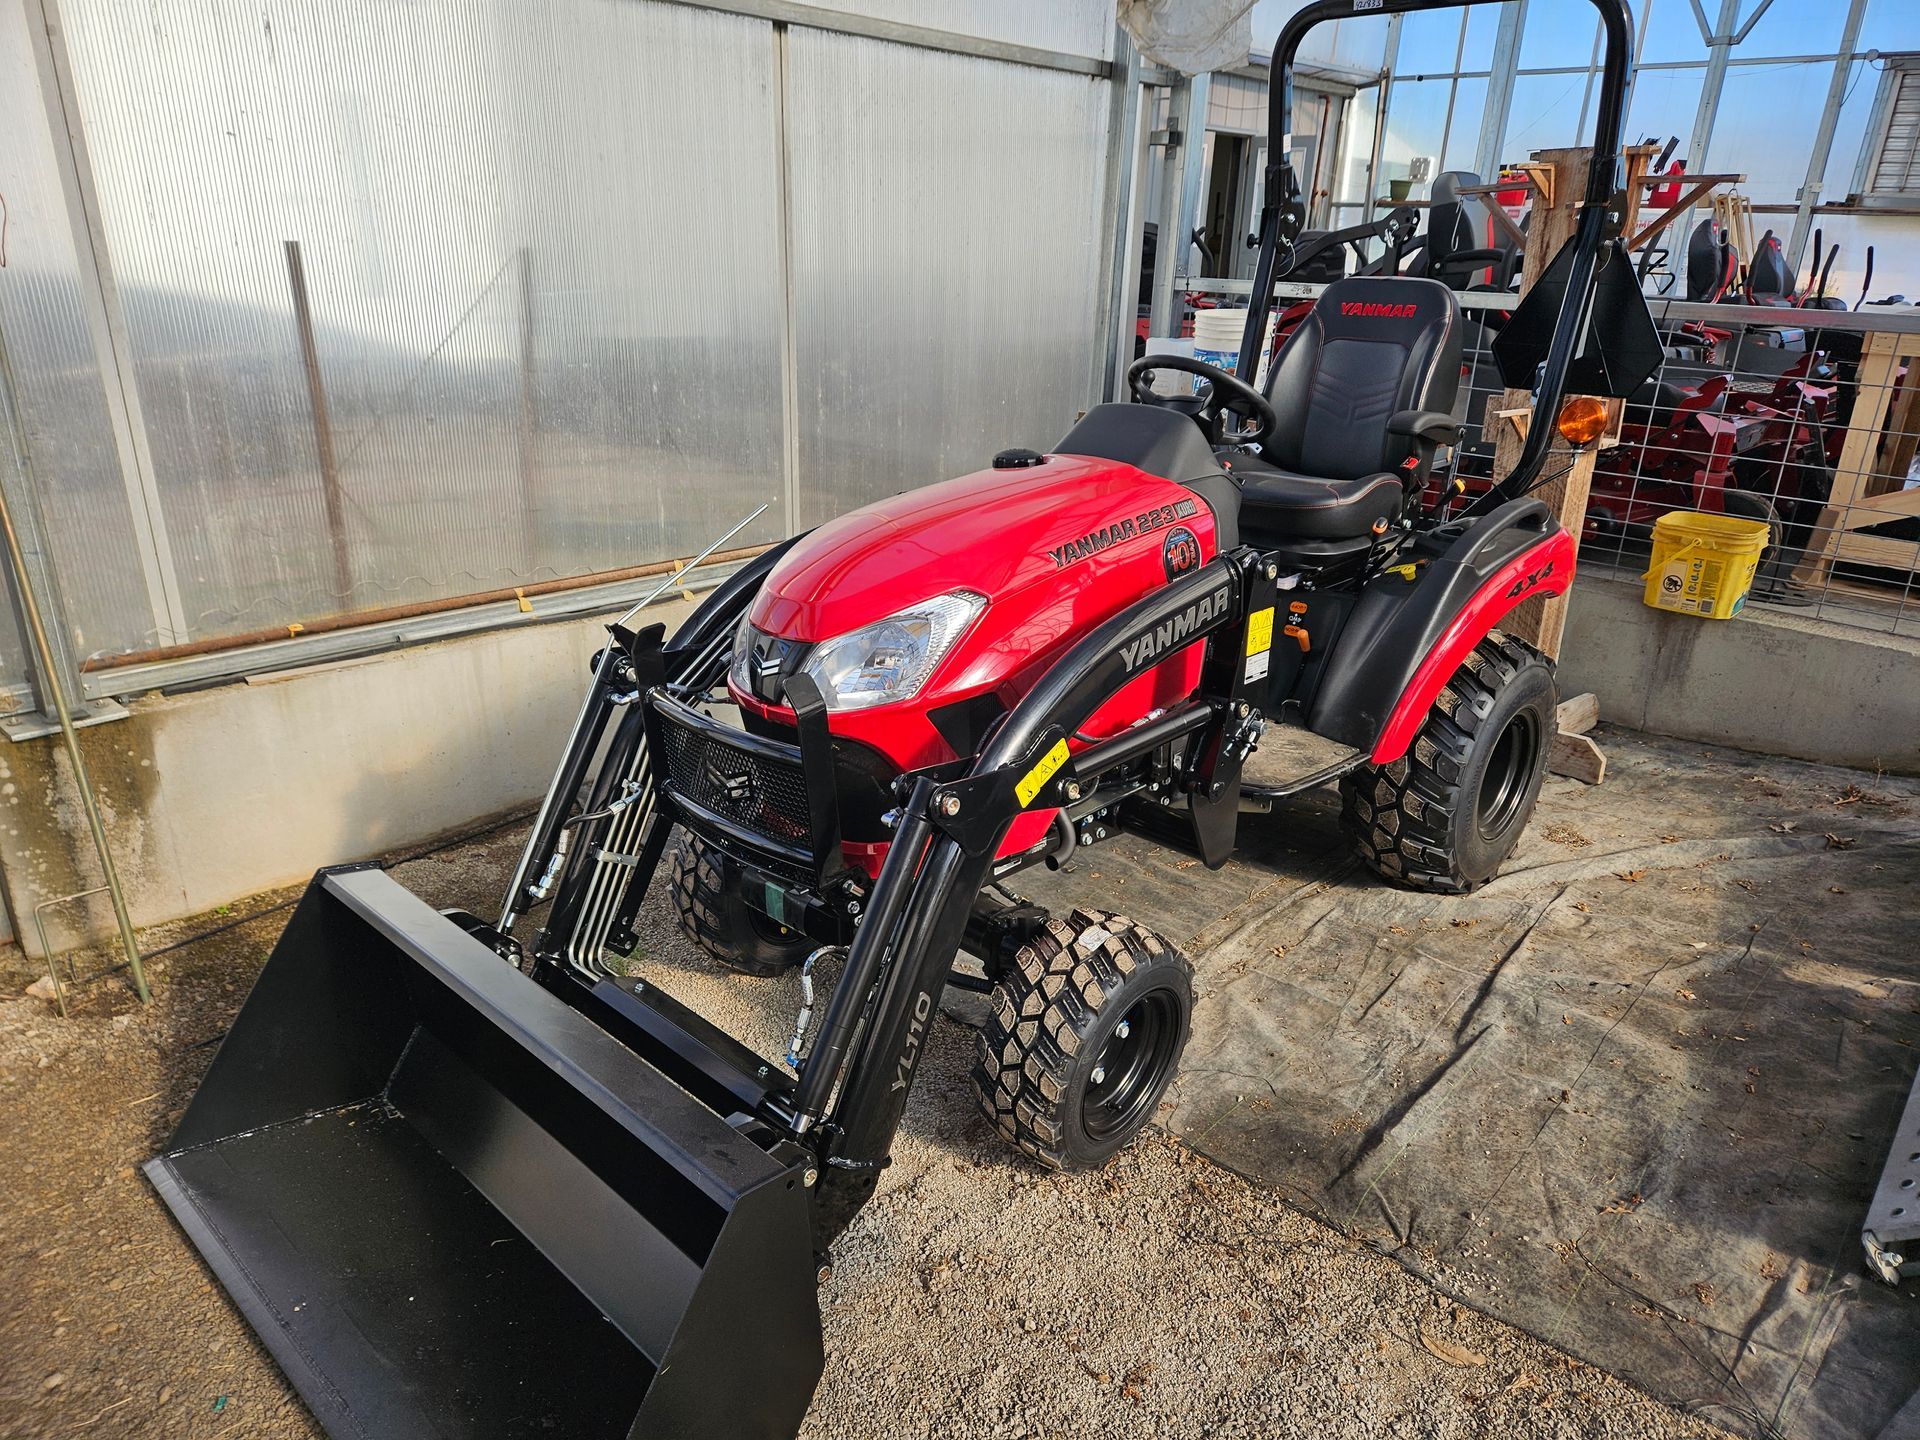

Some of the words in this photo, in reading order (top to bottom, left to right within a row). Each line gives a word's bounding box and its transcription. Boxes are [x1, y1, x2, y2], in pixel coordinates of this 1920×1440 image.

[1341, 302, 1417, 318] YANMAR
[1048, 518, 1137, 567] YANMAR
[1136, 504, 1175, 533] 223
[1175, 500, 1197, 519] KURO
[1167, 541, 1190, 572] 10
[1505, 560, 1554, 599] 4X4
[1119, 586, 1229, 673] YANMAR
[890, 991, 931, 1092] YL110
